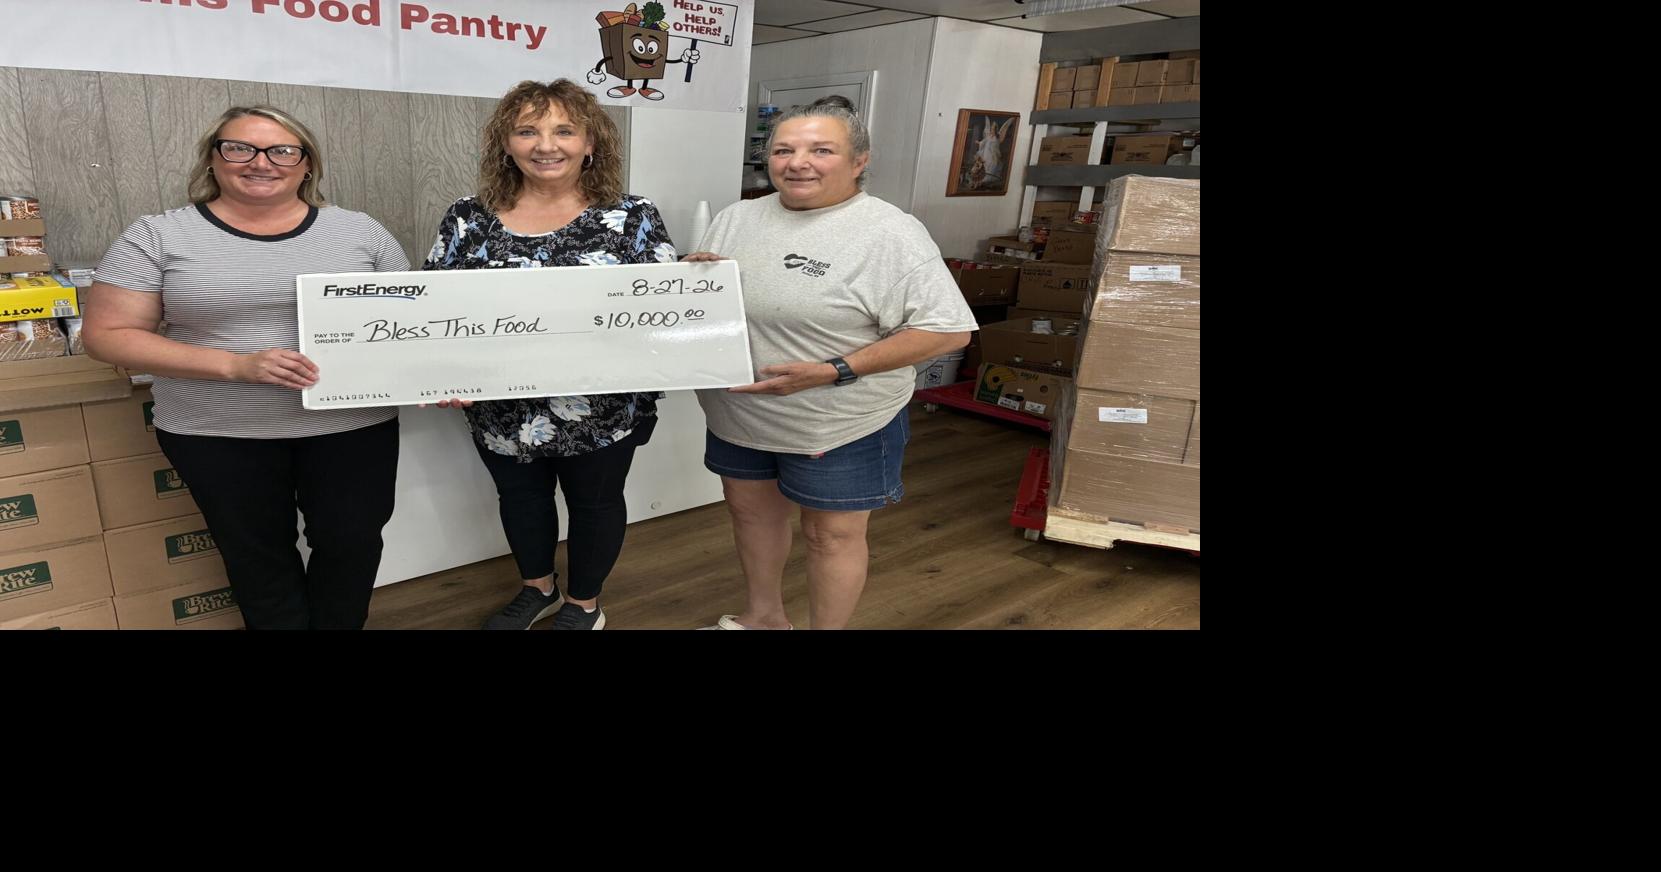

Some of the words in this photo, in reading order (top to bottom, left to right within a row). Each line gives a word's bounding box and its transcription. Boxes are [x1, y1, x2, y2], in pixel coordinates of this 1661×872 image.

[673, 0, 704, 12] HELP
[709, 5, 725, 17] US,
[400, 3, 548, 50] Pantry
[684, 13, 717, 26] HELP
[673, 21, 722, 37] OTHERS!
[631, 278, 724, 296] 8-27-26
[363, 319, 430, 342] Bless
[428, 316, 486, 337] This
[492, 314, 549, 336] Food
